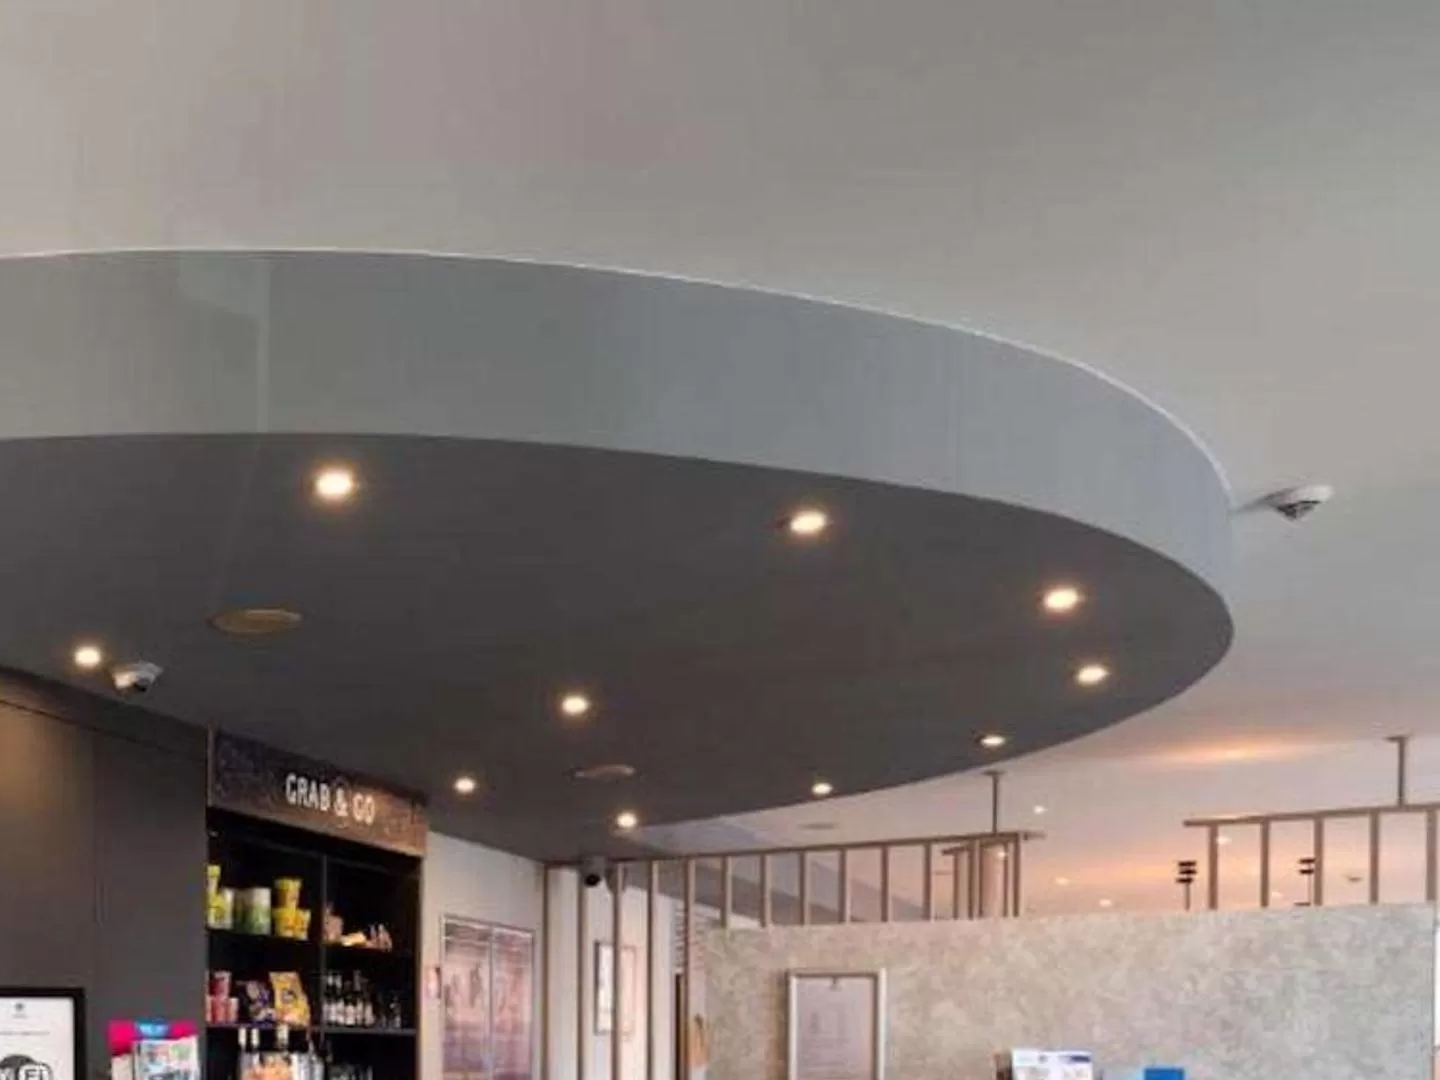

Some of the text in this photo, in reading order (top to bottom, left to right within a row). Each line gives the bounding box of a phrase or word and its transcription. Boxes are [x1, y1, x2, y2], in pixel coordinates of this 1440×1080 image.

[286, 772, 375, 825] GRAB & GO
